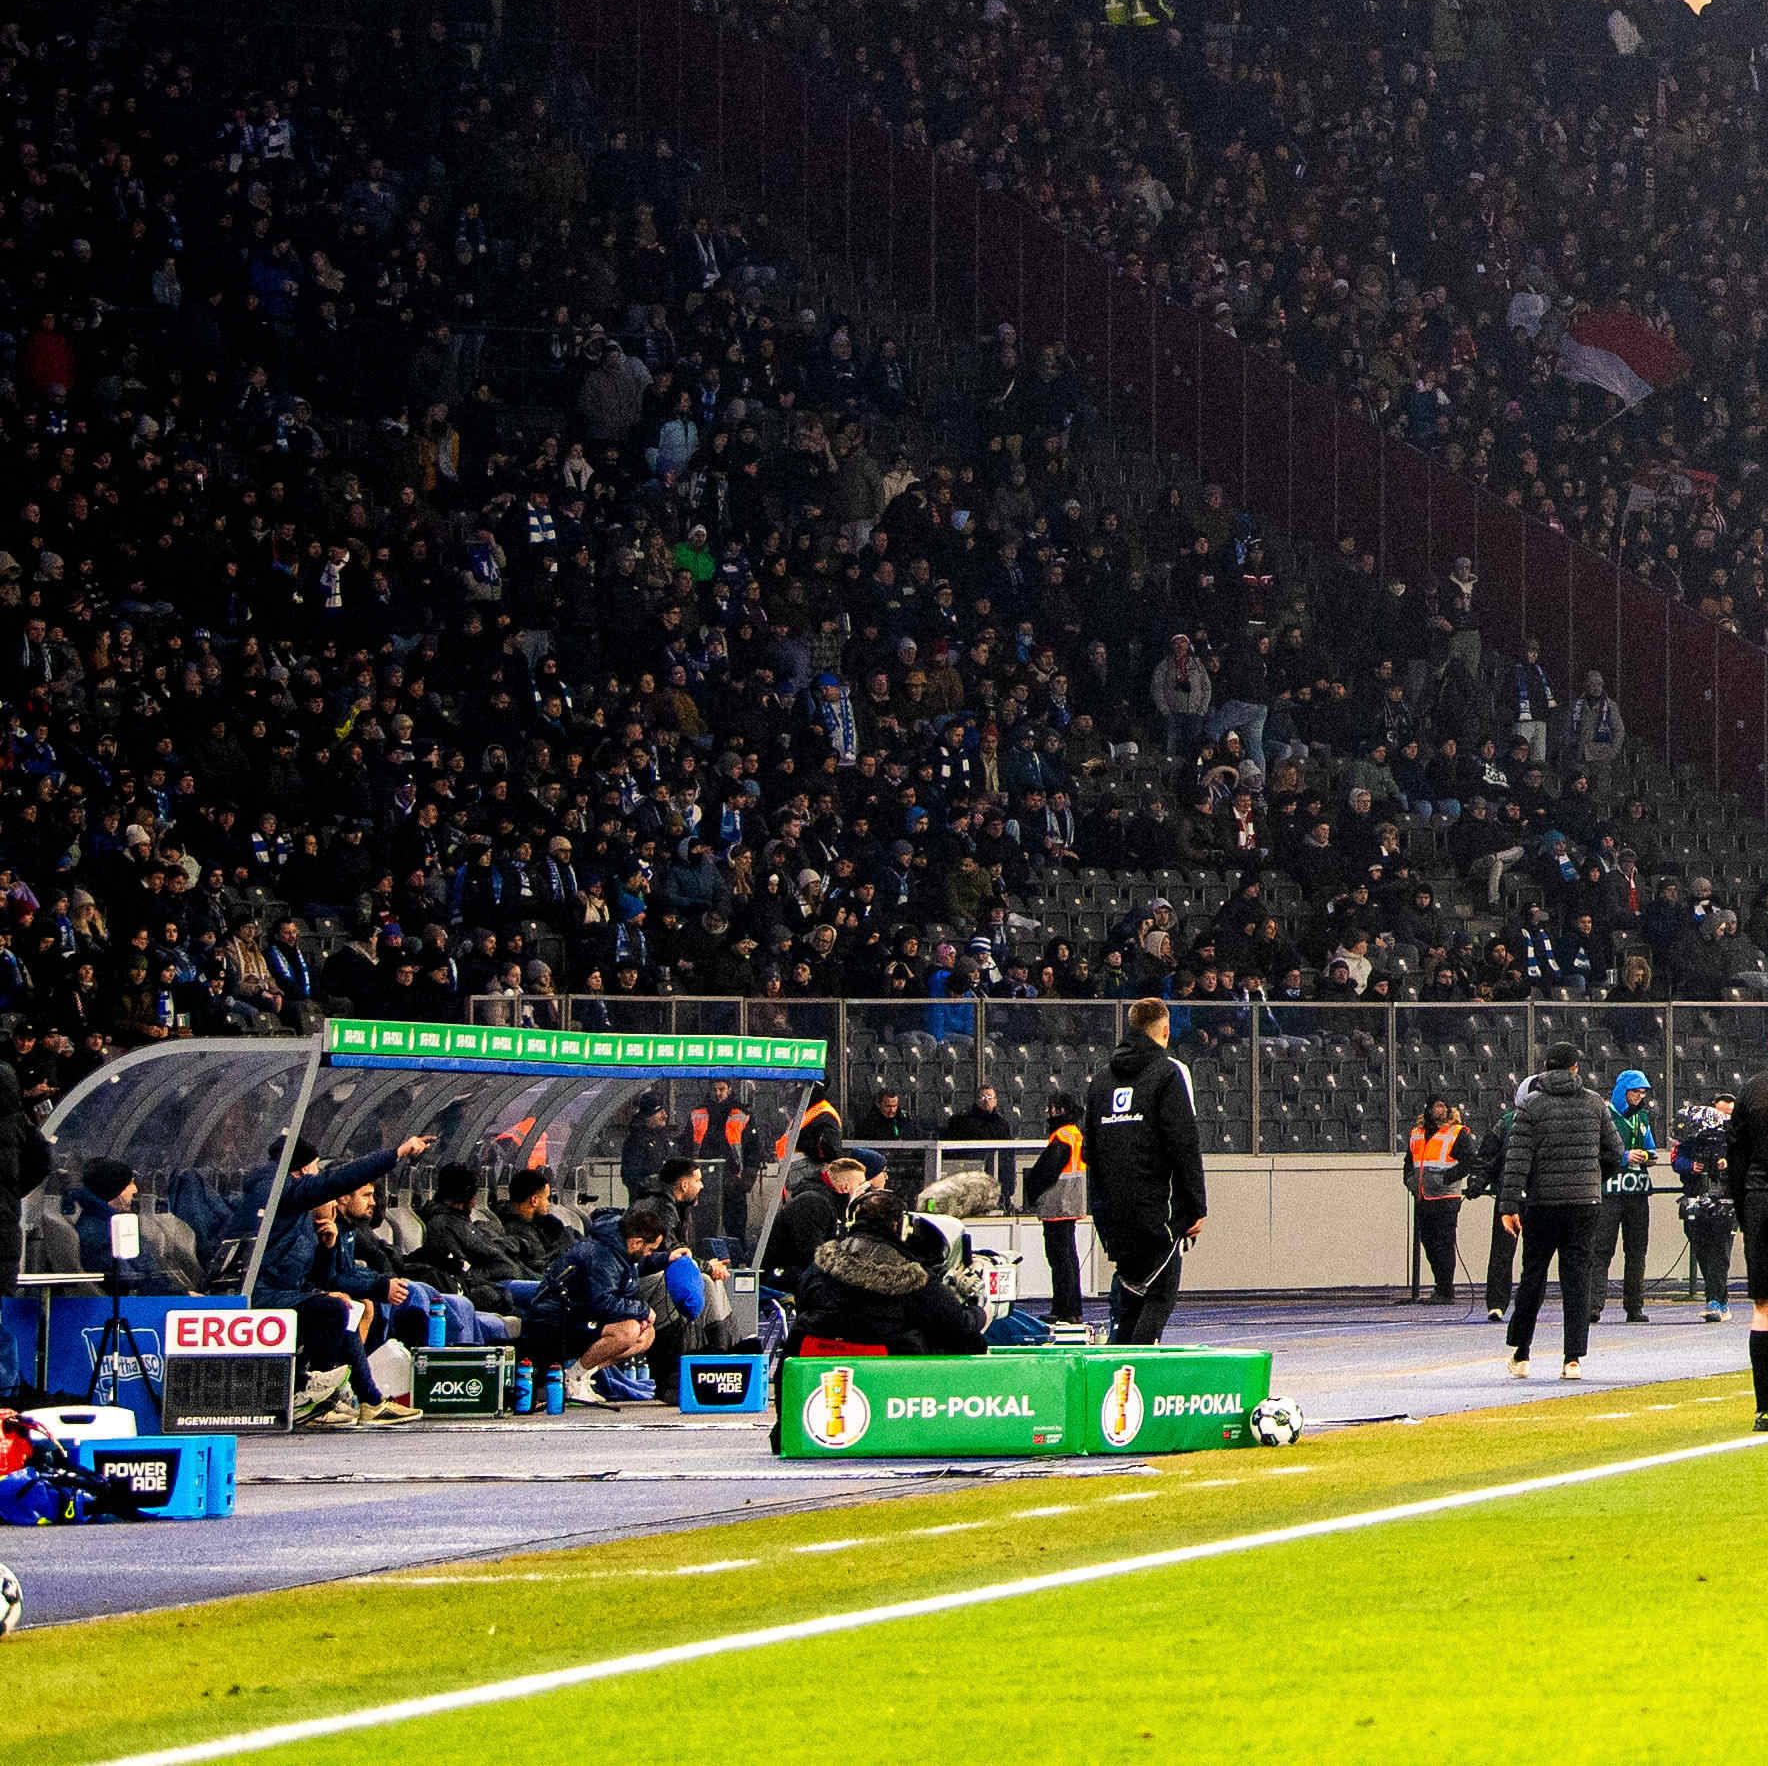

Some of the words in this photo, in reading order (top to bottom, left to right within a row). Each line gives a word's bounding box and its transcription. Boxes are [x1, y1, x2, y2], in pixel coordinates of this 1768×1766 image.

[176, 1316, 287, 1347] ERGO
[102, 1357, 138, 1375] Htha
[697, 1372, 743, 1384] POWER
[430, 1381, 465, 1395] AOK
[717, 1383, 743, 1394] ADE
[886, 1395, 1035, 1419] DFB-POKAL
[1152, 1393, 1244, 1417] DFB-POKAL
[176, 1415, 276, 1426] #GEWINNERBLEIBT
[103, 1461, 168, 1478] POWER
[132, 1476, 168, 1492] ADE
